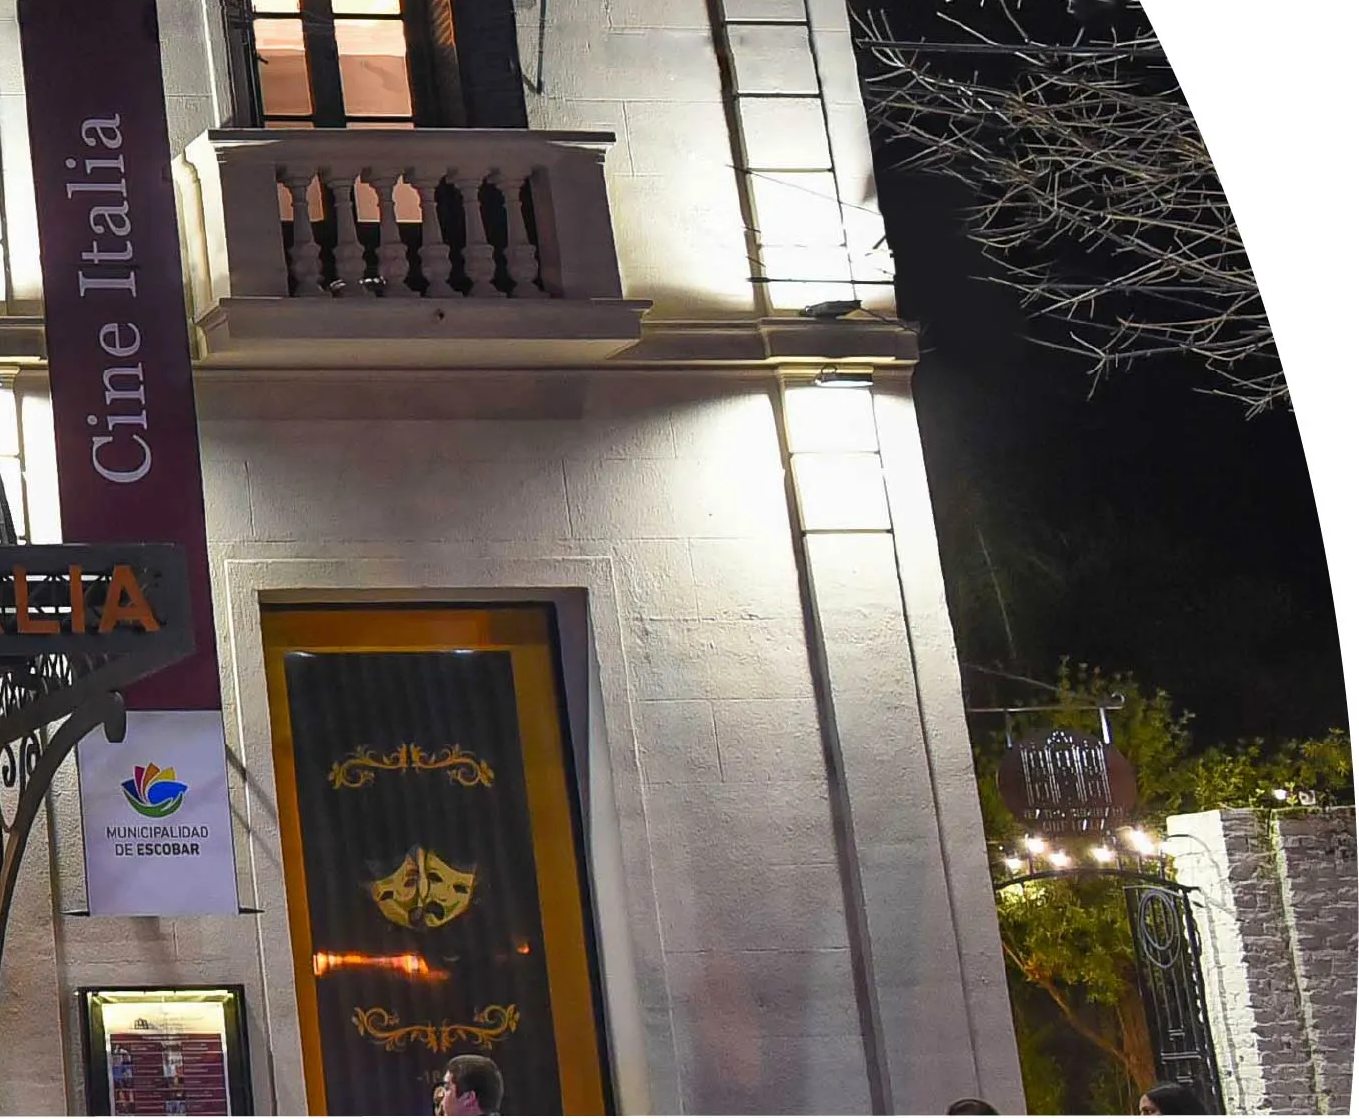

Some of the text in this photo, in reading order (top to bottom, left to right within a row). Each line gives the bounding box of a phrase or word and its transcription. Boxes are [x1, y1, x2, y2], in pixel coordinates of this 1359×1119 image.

[66, 113, 153, 483] Cine Italia
[106, 826, 209, 840] MUNICIPALIDAD
[115, 843, 200, 856] DE ESCOBAR
